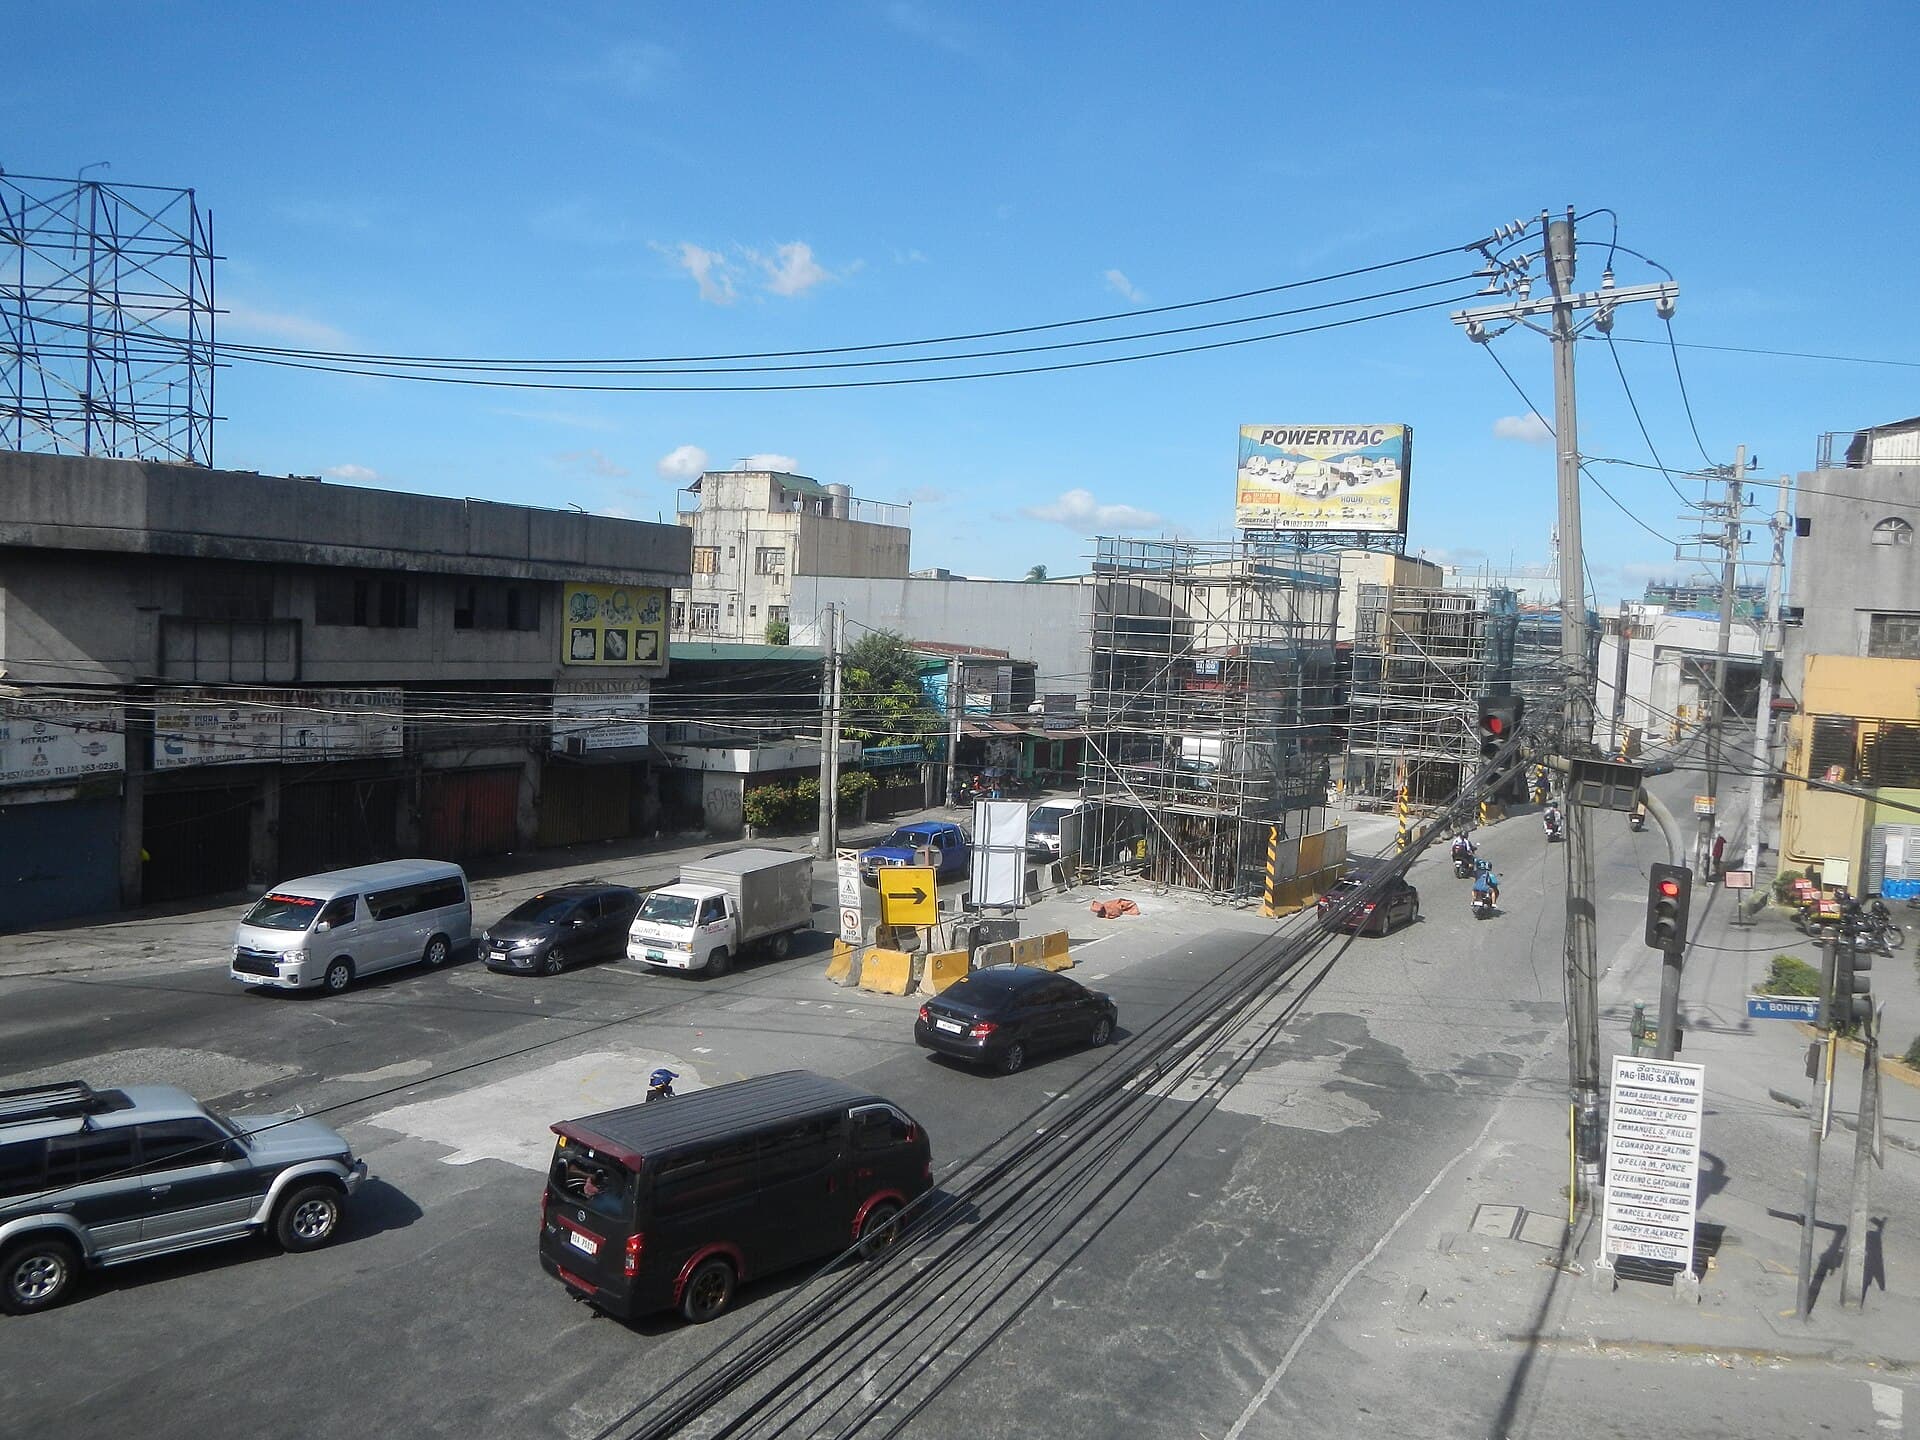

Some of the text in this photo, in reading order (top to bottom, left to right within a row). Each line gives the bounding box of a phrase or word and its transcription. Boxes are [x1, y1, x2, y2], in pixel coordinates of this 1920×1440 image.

[1260, 429, 1384, 446] POWERTRAC
[21, 735, 58, 745] HITACHI
[1755, 1003, 1765, 1011] A.
[1637, 1064, 1681, 1077] Barangay
[1619, 1070, 1695, 1087] PAG-IBIG SA NAYON
[1618, 1106, 1657, 1117] ADORACION
[1617, 1123, 1657, 1134] EMMANUEL
[1616, 1140, 1654, 1150] LEONARDO
[1618, 1157, 1686, 1173] OFELIA M. PONCE
[1612, 1173, 1645, 1183] CEFERINO
[1652, 1178, 1690, 1189] GATCHALIAN
[1617, 1208, 1645, 1218] MARCEL
[1654, 1212, 1681, 1222] FLORES
[1612, 1223, 1643, 1233] AUDREY
[1651, 1229, 1684, 1240] ALVAREZ
